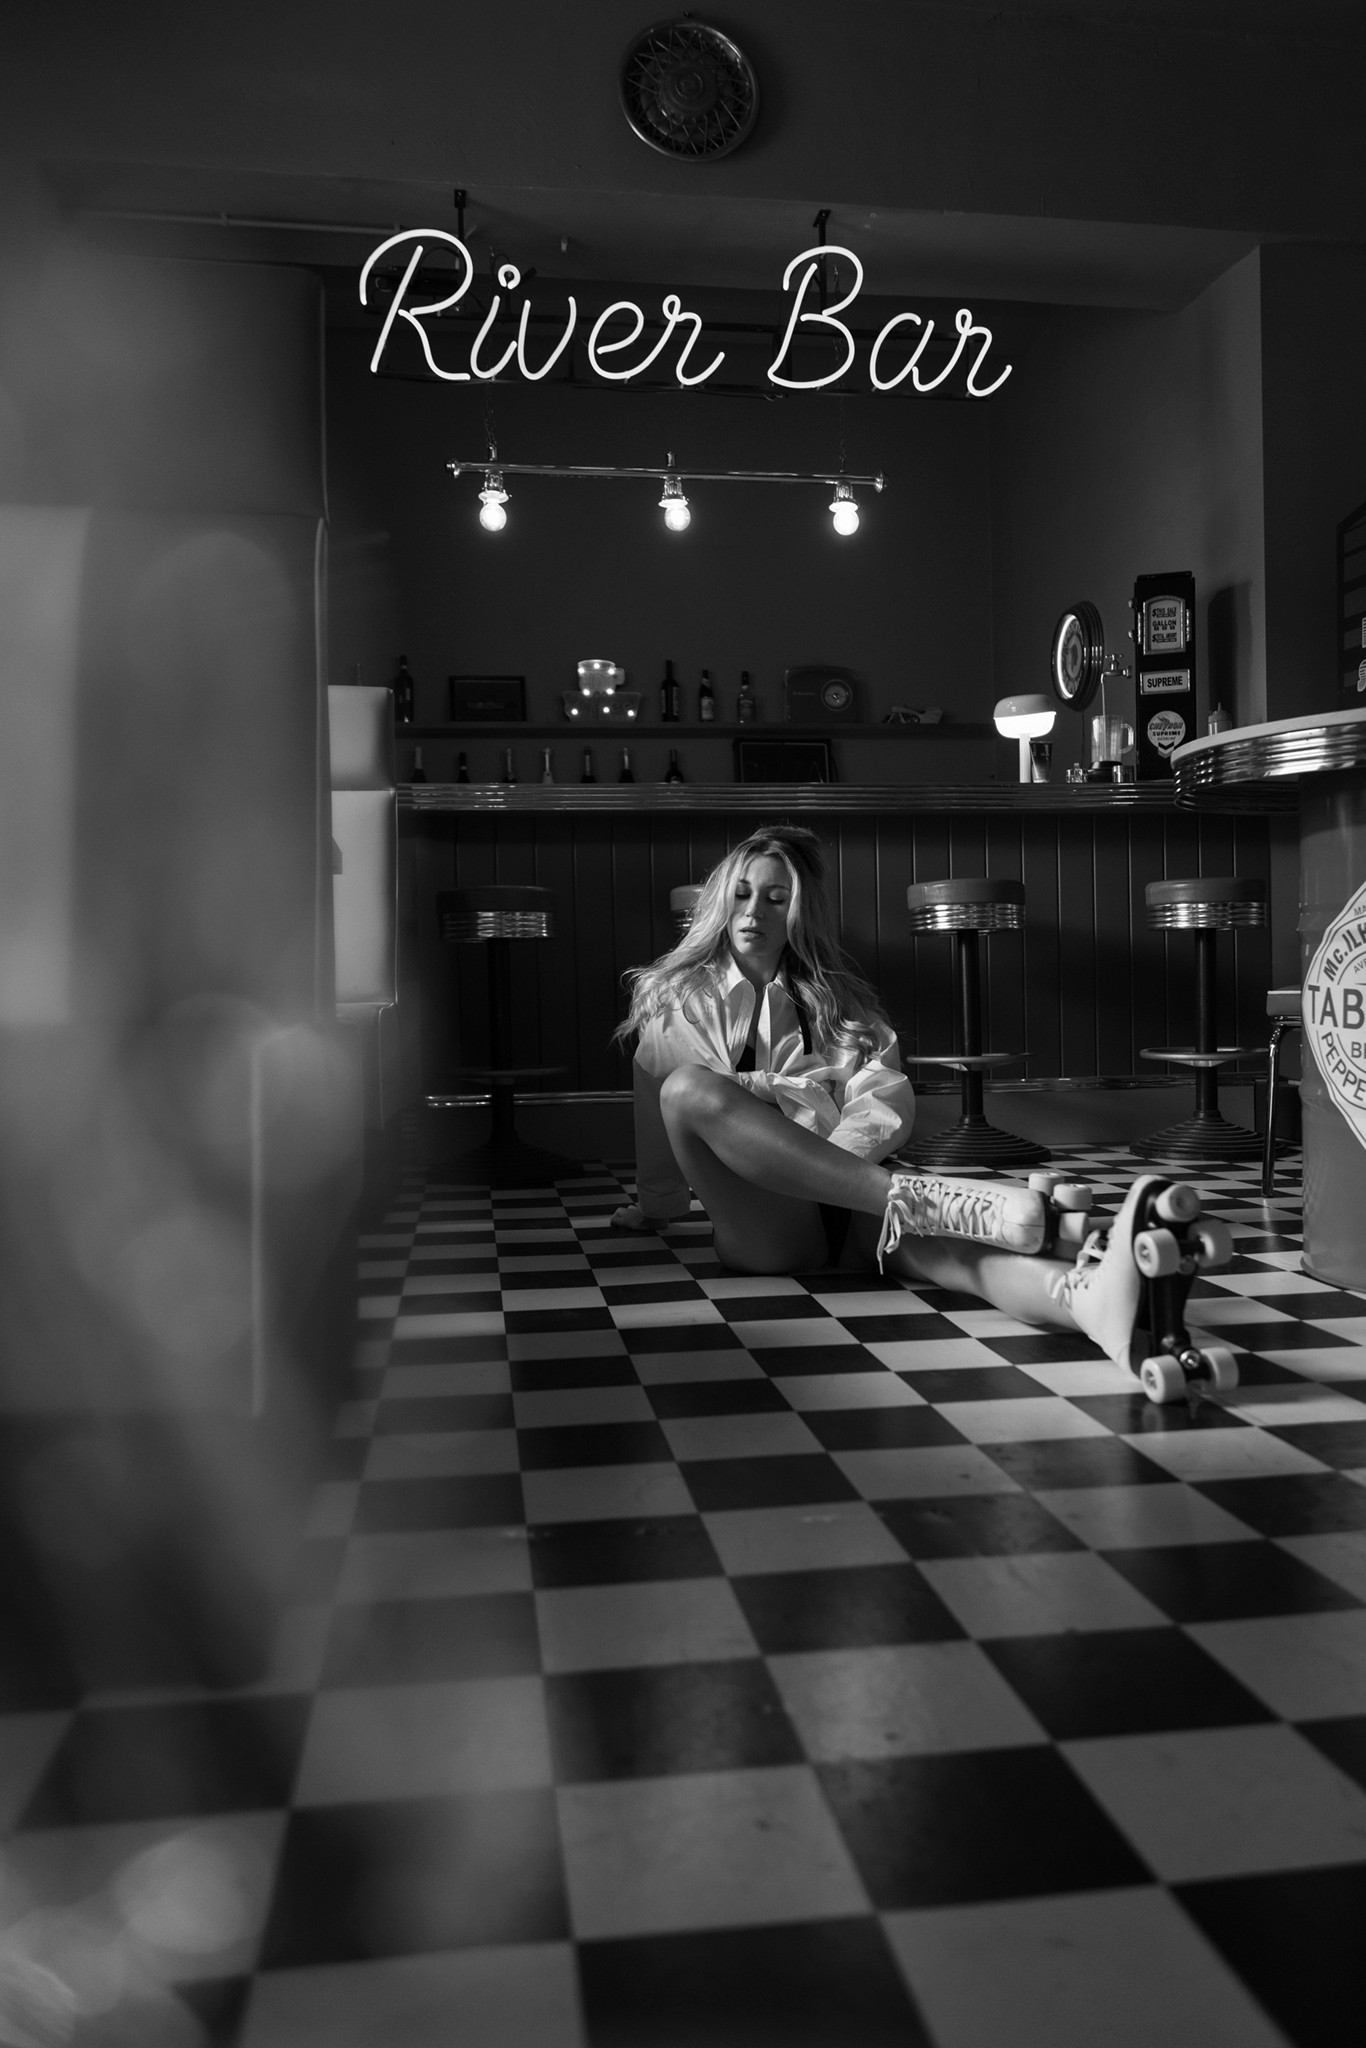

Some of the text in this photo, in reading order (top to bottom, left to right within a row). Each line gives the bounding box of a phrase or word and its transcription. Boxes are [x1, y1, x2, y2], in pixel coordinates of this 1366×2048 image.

[359, 228, 1013, 397] River Bar
[1152, 619, 1177, 627] GALLON
[1147, 675, 1183, 688] SUPREME
